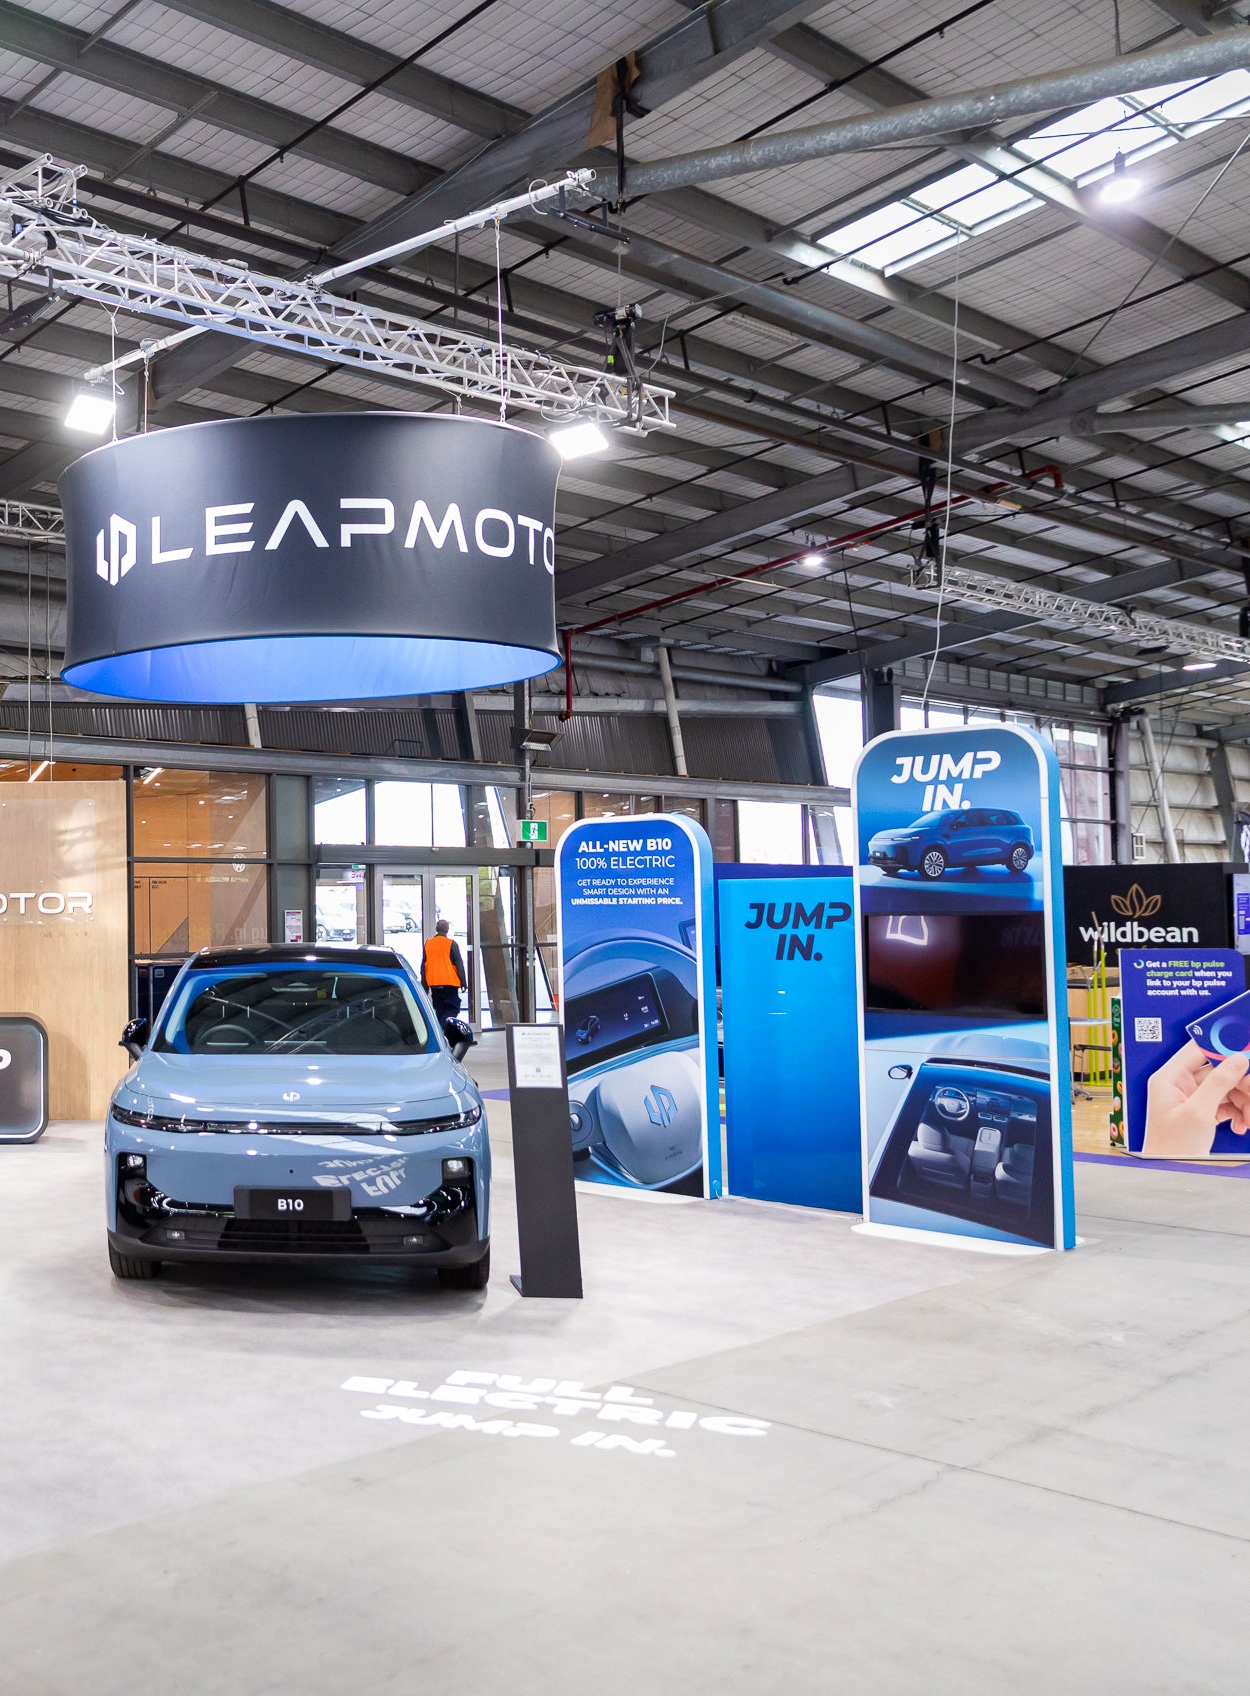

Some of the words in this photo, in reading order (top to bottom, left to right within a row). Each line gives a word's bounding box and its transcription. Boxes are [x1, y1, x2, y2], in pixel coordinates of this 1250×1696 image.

[890, 750, 1002, 784] JUMP
[921, 783, 972, 811] IN.
[578, 839, 643, 853] ALL-NEW
[646, 838, 672, 850] B10
[575, 857, 607, 869] 100%
[610, 855, 676, 869] ELECTRIC
[744, 902, 852, 929] JUMP
[1079, 921, 1199, 943] wildbean
[775, 934, 823, 961] IN.
[1146, 970, 1173, 978] charge
[1172, 980, 1190, 988] your
[1191, 979, 1202, 987] bp
[1203, 979, 1226, 987] pulse
[277, 1198, 304, 1210] B10
[445, 1370, 654, 1405] FULL
[340, 1375, 772, 1437] ELECTRIC
[360, 1404, 560, 1438] JUMP
[570, 1431, 676, 1458] IN.
